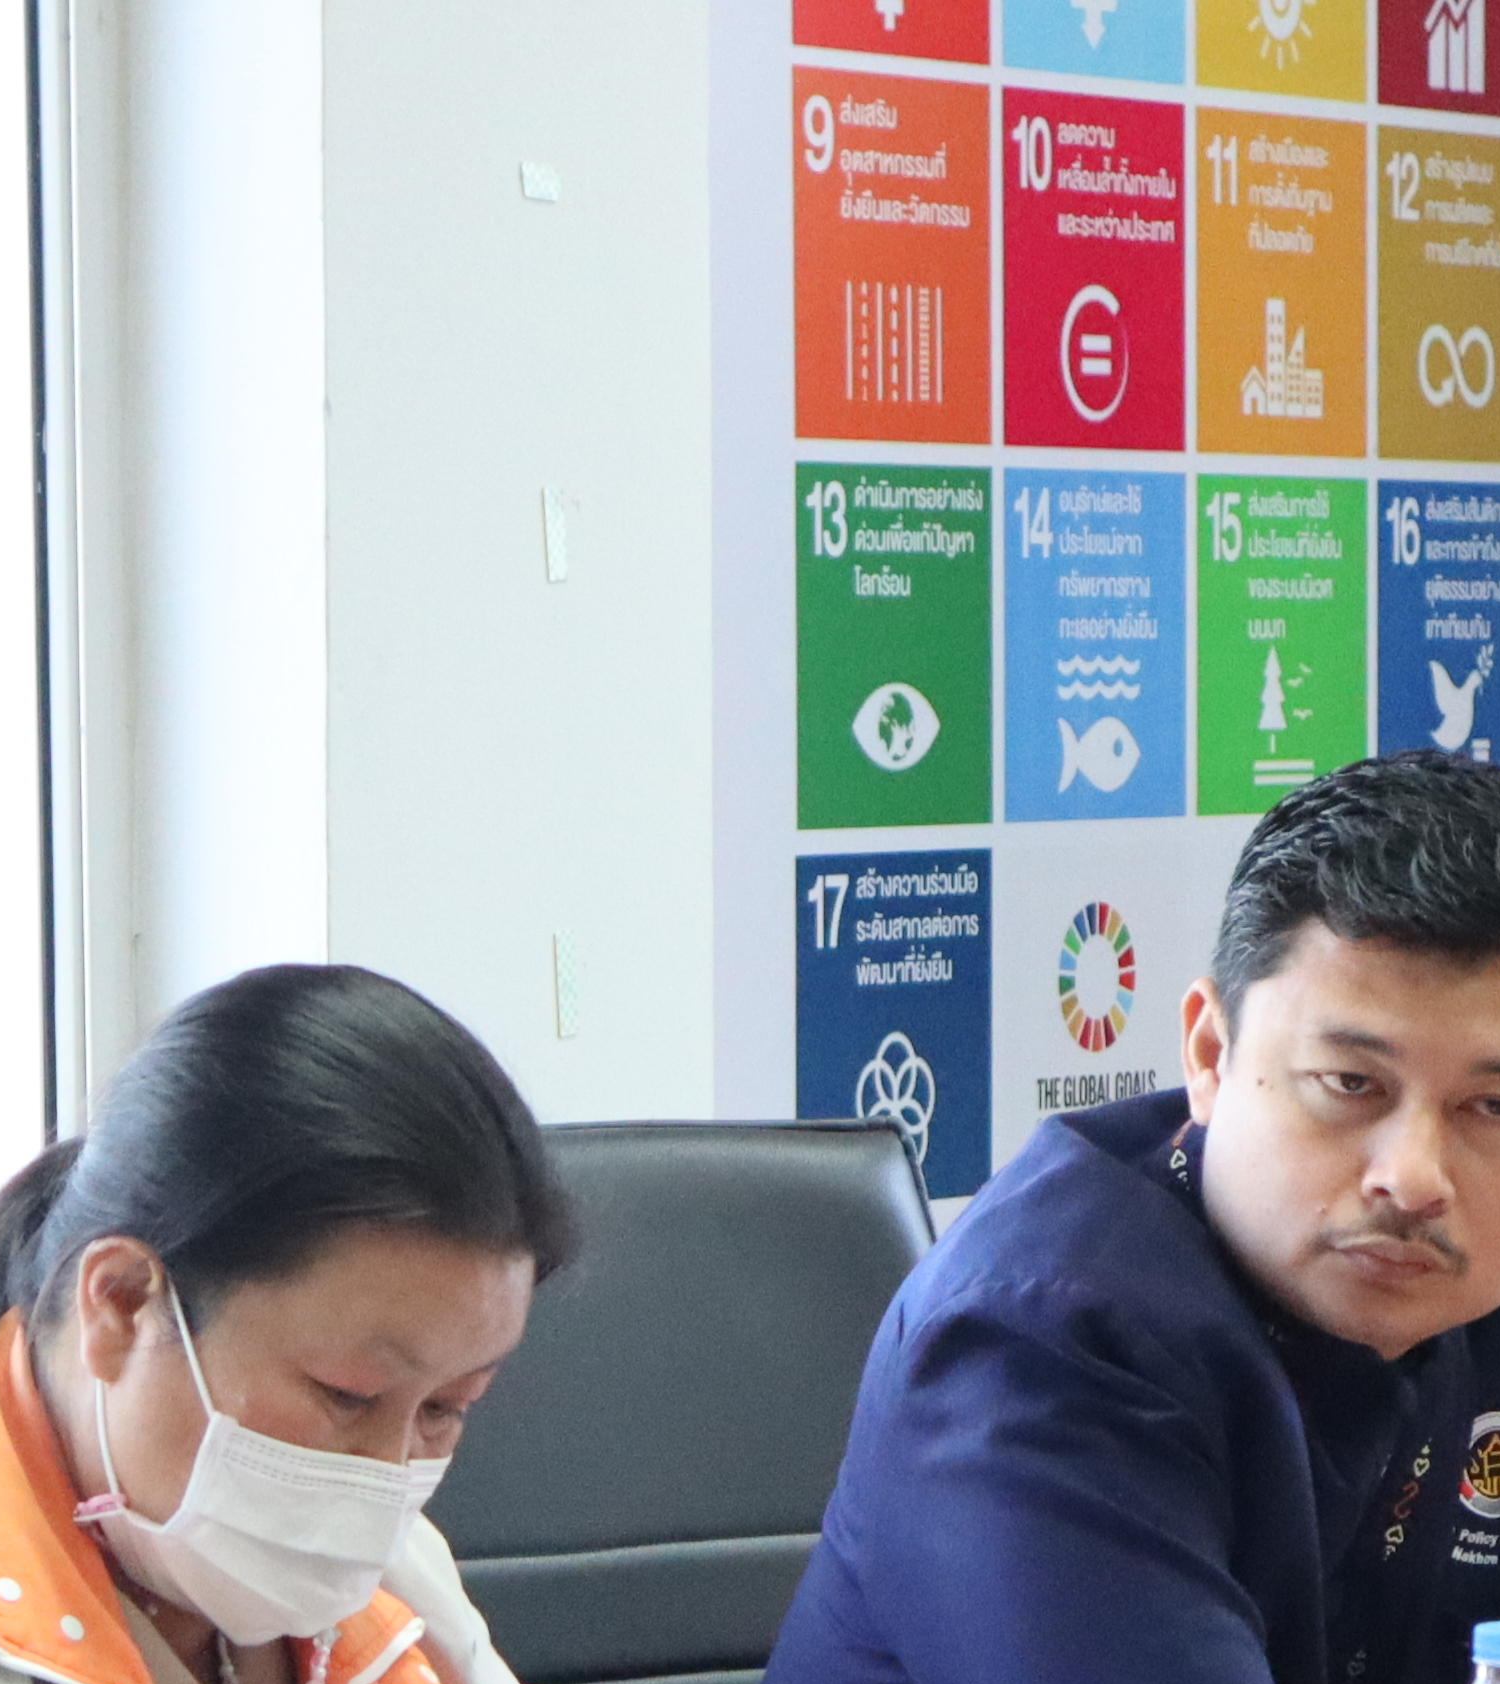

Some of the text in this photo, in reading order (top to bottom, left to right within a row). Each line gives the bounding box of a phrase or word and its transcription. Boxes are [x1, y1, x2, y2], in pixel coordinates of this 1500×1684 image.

[840, 94, 897, 129] ส่งเสริม
[803, 95, 835, 174] 9
[1012, 116, 1053, 192] 10
[1057, 122, 1116, 150] ลดความ
[1206, 134, 1238, 206] 11
[1385, 151, 1421, 222] 12
[806, 481, 848, 558] 13
[1014, 486, 1054, 559] 14
[1206, 491, 1243, 563] 15
[1385, 496, 1421, 566] 16
[854, 564, 911, 597] โลกร้อน
[1248, 617, 1286, 640] บนบก
[855, 862, 979, 899] สร้างความร่วมมือ
[807, 873, 850, 950] 17
[855, 906, 979, 942] ระดับสากลต่อการ
[856, 943, 953, 987] พัฒนาที่ยั่งยืน
[1037, 1068, 1156, 1110] THE GLOBAL GOALS
[1451, 1545, 1499, 1565] Nakhon
[1458, 1527, 1499, 1548] Policy
